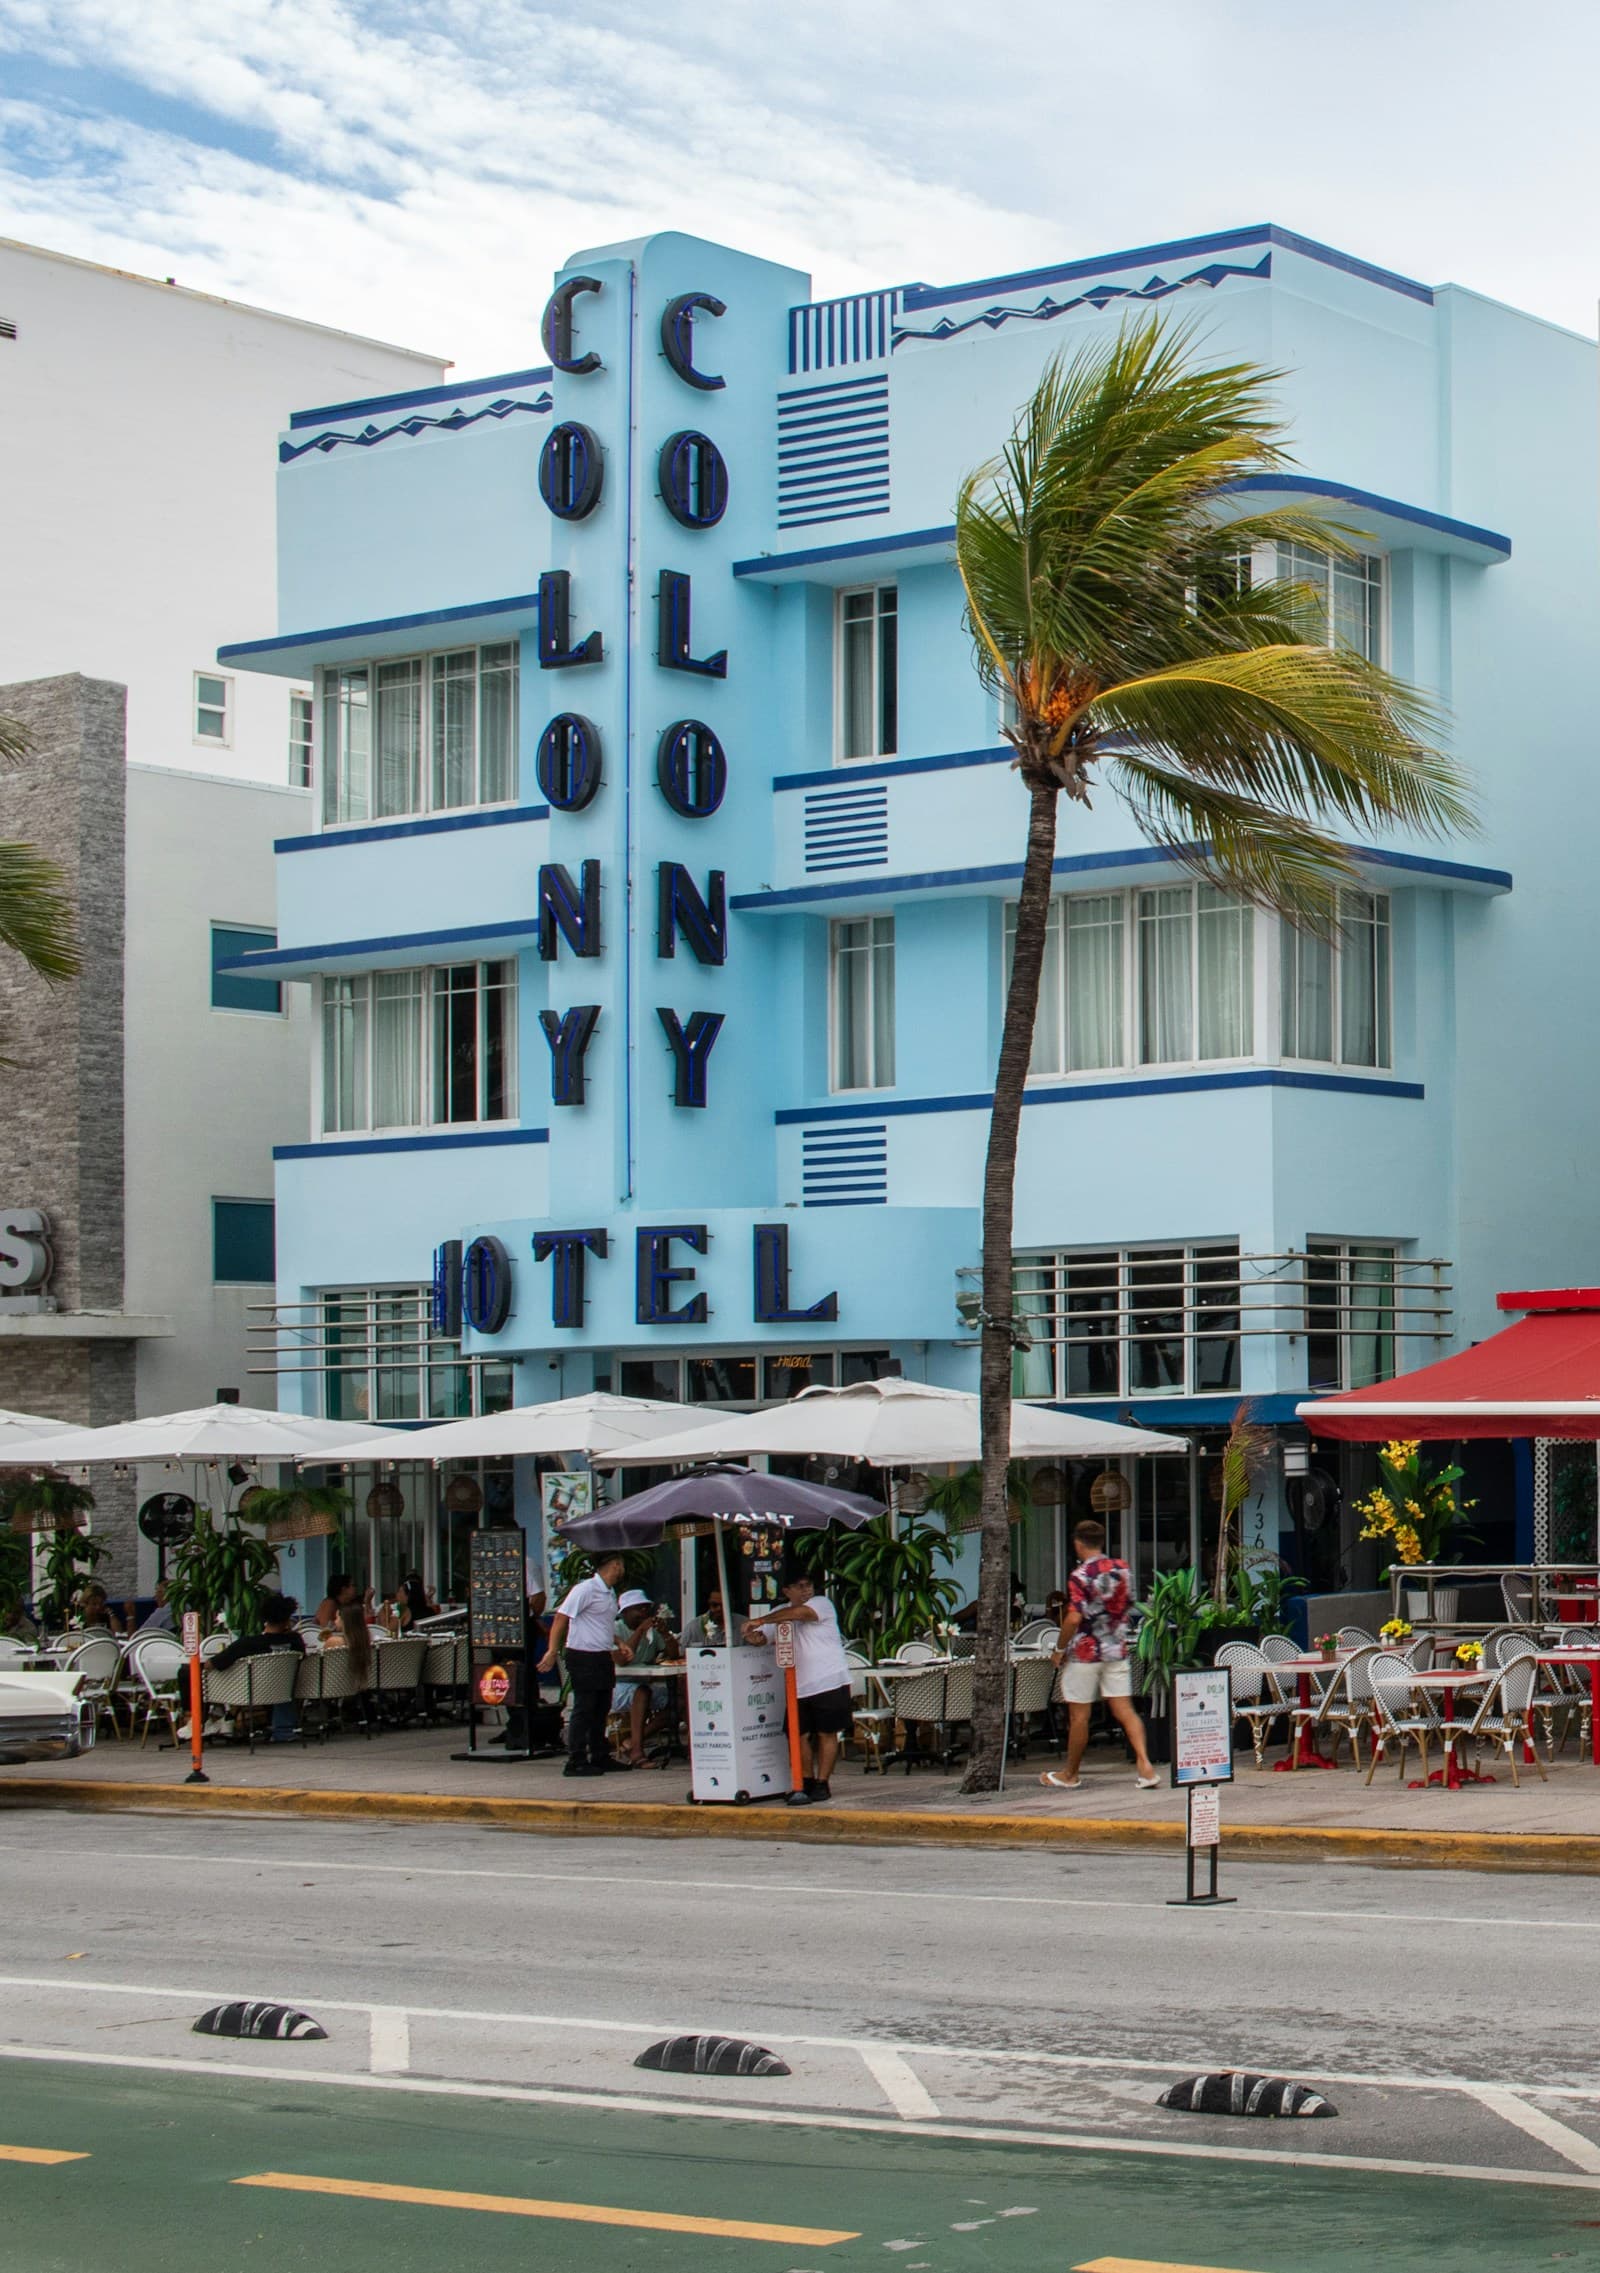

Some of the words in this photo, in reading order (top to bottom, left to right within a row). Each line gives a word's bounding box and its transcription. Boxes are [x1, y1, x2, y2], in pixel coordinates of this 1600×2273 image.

[538, 275, 604, 1106] COLONY
[656, 291, 729, 1108] COLONY
[712, 1512, 795, 1527] VALET
